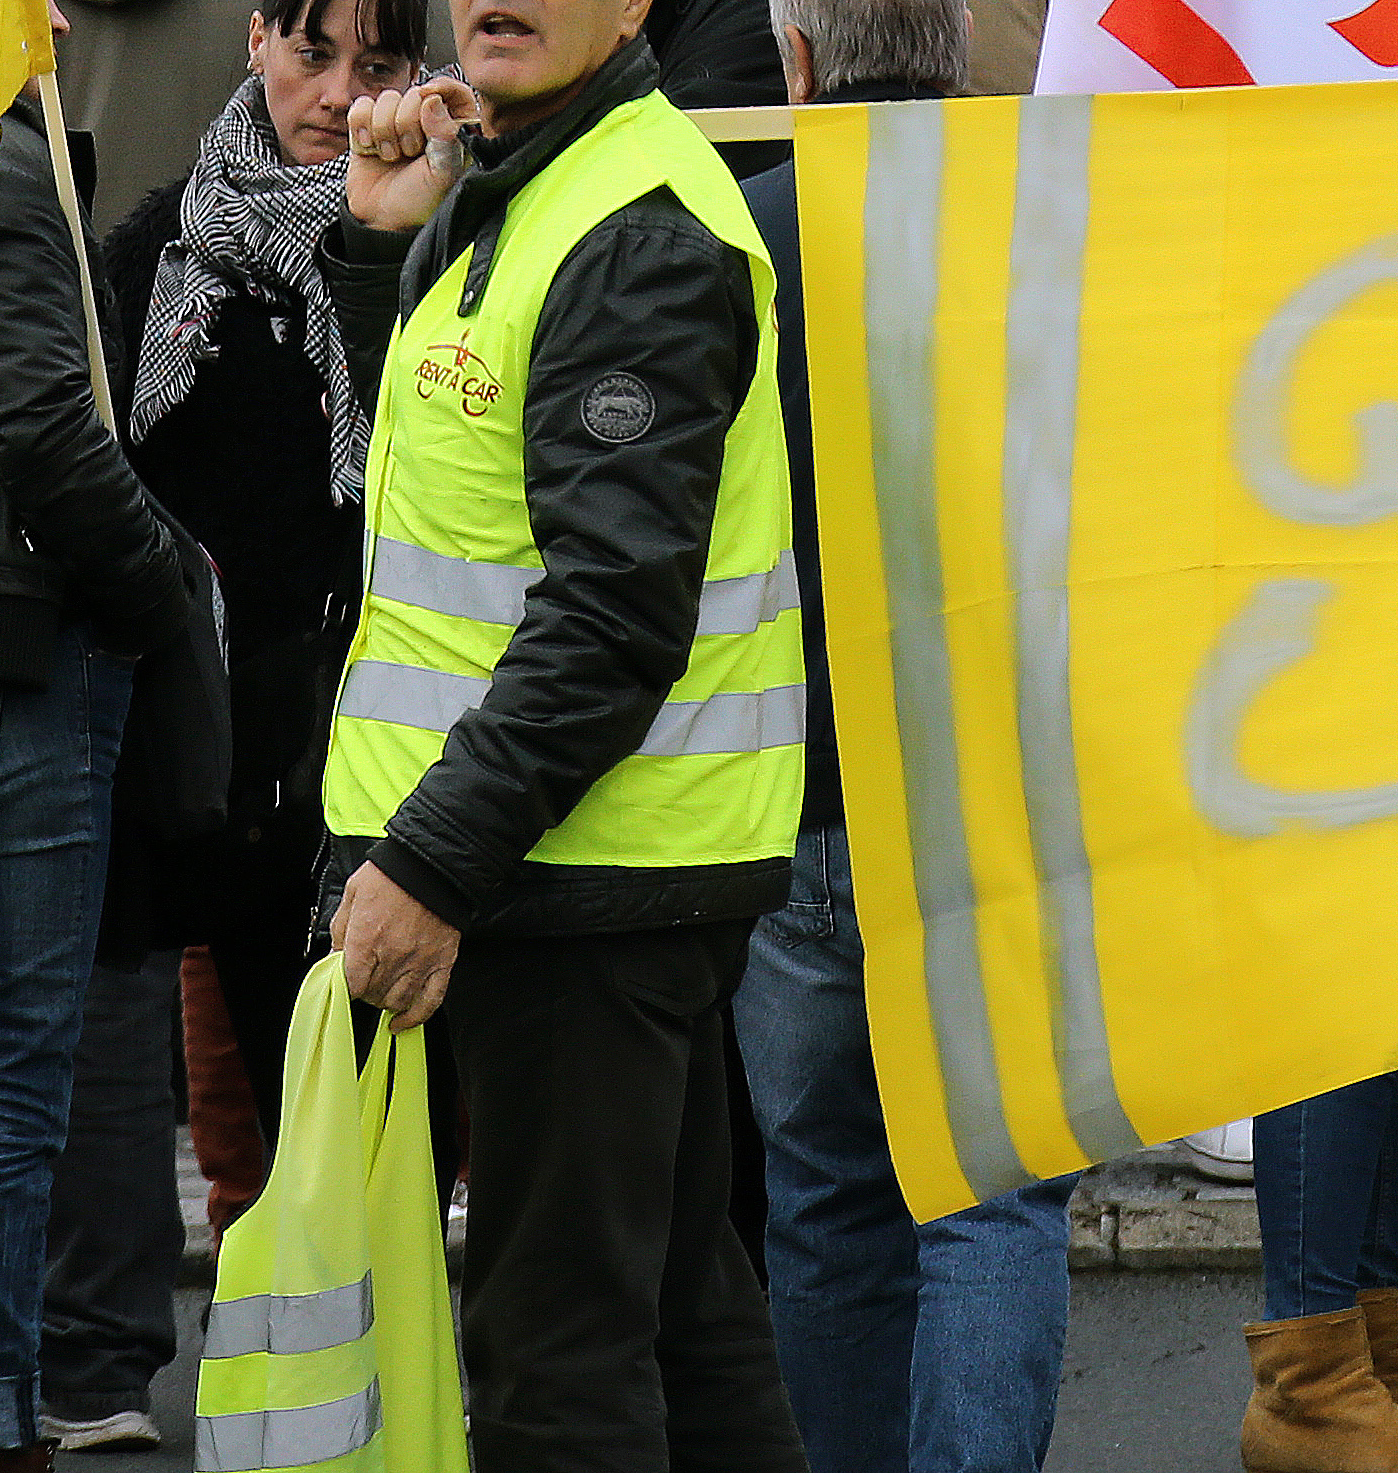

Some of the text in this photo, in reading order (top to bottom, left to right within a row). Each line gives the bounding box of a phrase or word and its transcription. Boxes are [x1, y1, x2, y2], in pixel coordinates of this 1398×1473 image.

[414, 358, 499, 403] RENT A CAR
